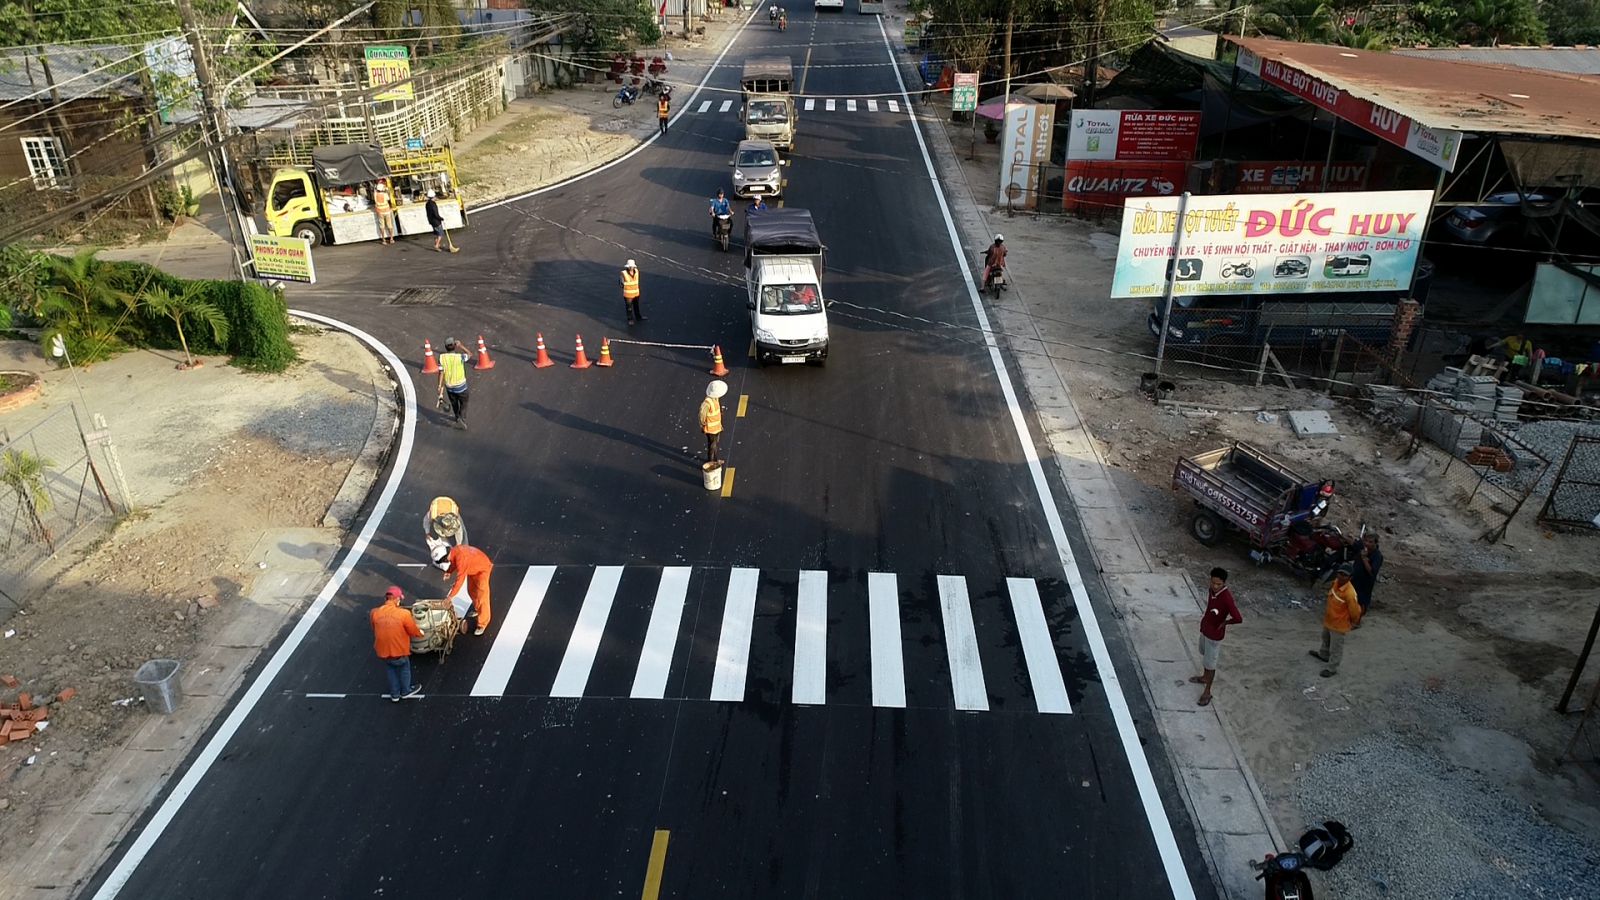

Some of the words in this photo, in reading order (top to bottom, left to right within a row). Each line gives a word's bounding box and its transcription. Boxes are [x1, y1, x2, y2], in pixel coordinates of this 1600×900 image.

[371, 63, 389, 84] PHÚ
[1281, 68, 1292, 83] XE
[1292, 72, 1311, 93] BỌT
[1124, 113, 1143, 121] RỬA
[1158, 113, 1176, 121] ĐỨC
[1370, 105, 1403, 133] HUY
[1014, 109, 1029, 172] TOTAL
[1420, 128, 1439, 143] TOTAL
[1067, 175, 1148, 193] QUARTZ
[1241, 169, 1265, 182] XE
[1132, 202, 1157, 235] RỬA
[1159, 210, 1176, 234] XE
[1185, 210, 1203, 238] ỌT
[1204, 202, 1240, 233] TUYẾT
[1245, 199, 1335, 238] ĐỨC
[1348, 213, 1417, 236] HUY
[255, 245, 274, 255] PHONG
[1133, 243, 1164, 257] CHUYÊN
[1185, 245, 1197, 256] XE
[1203, 243, 1213, 259] VỆ
[1215, 245, 1233, 255] SINH
[1234, 241, 1250, 257] NỘI
[1252, 240, 1273, 254] THẤT
[1279, 241, 1299, 256] GIẶT
[1324, 242, 1345, 253] THAY
[1346, 238, 1370, 252] NHỚT
[1375, 241, 1394, 251] BƠM
